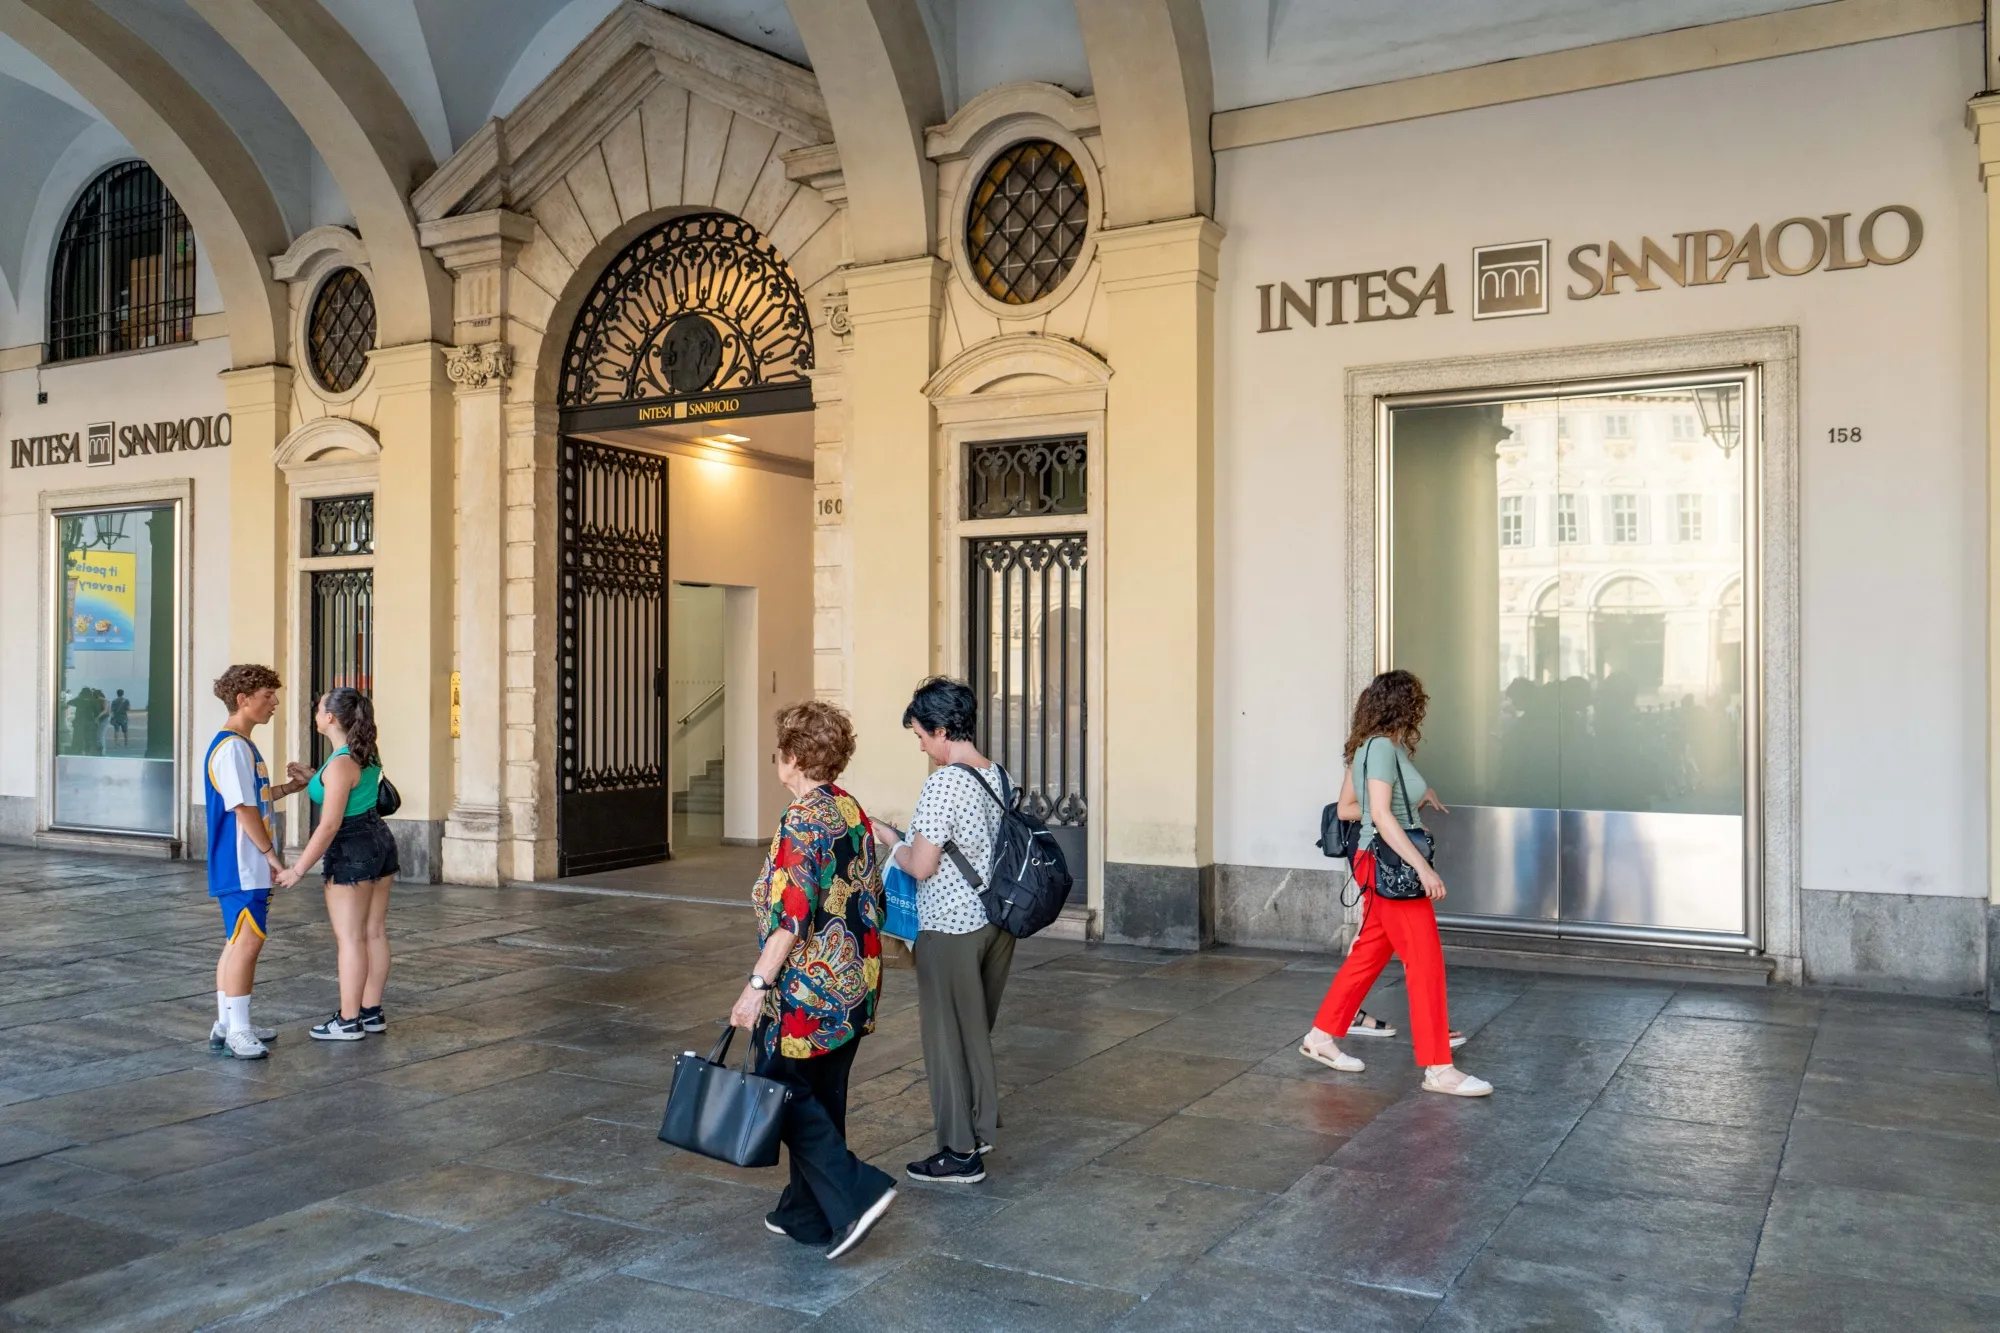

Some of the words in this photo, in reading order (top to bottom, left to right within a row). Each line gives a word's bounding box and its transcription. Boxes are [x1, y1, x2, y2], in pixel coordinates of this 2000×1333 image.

[1256, 263, 1454, 333] INTESA
[1566, 204, 1924, 301] SANPAOLO
[639, 406, 672, 421] INTESA
[688, 398, 740, 416] SANPAOLO
[10, 432, 82, 469] INTESA
[118, 412, 231, 459] SANPAOLO
[1828, 426, 1862, 443] 158
[817, 498, 843, 516] 160
